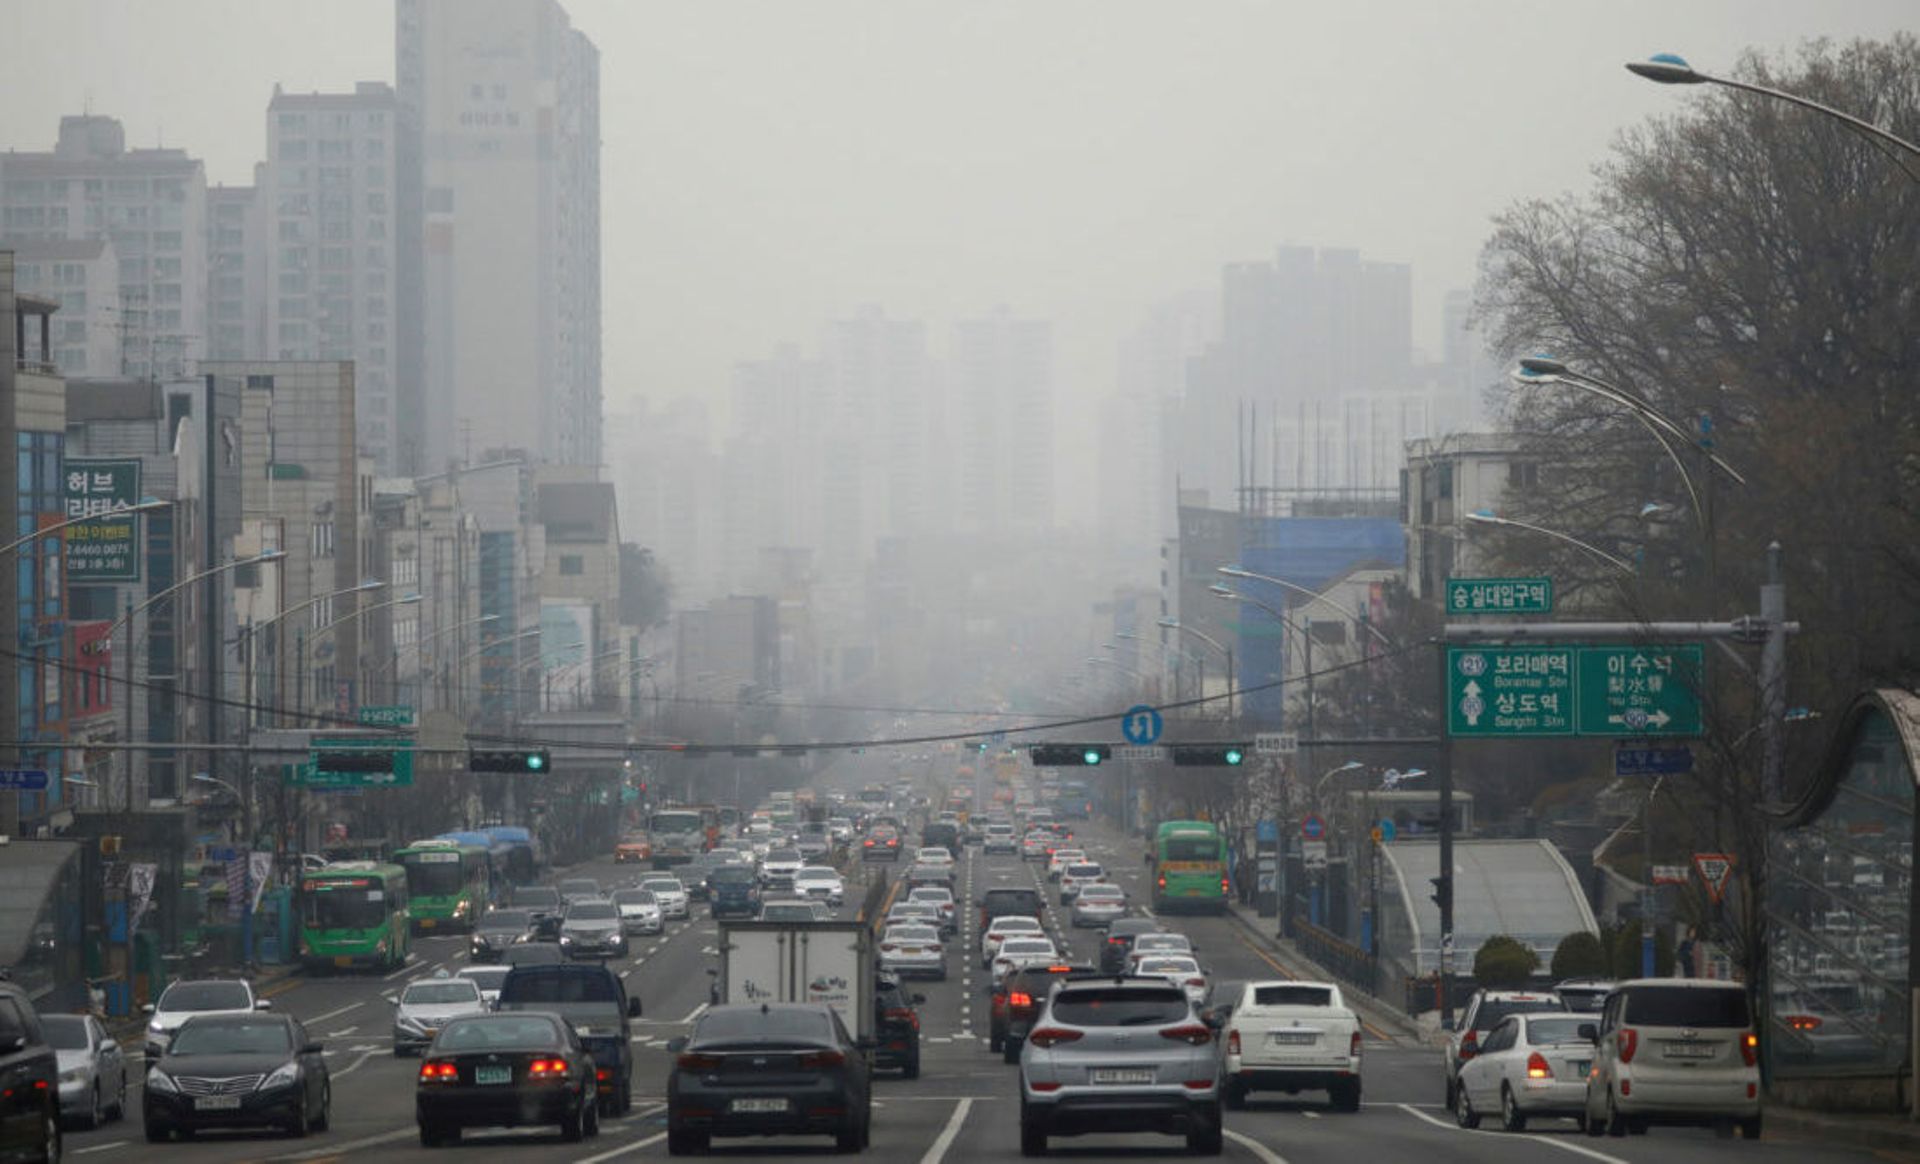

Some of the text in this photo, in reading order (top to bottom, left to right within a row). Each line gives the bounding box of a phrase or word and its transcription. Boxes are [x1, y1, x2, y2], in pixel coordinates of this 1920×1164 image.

[67, 472, 114, 494] 허브
[65, 498, 132, 520] 라테스
[1453, 583, 1546, 609] 숭실대입구역
[1494, 653, 1568, 675] 보라매역
[1495, 693, 1559, 713] 상도역
